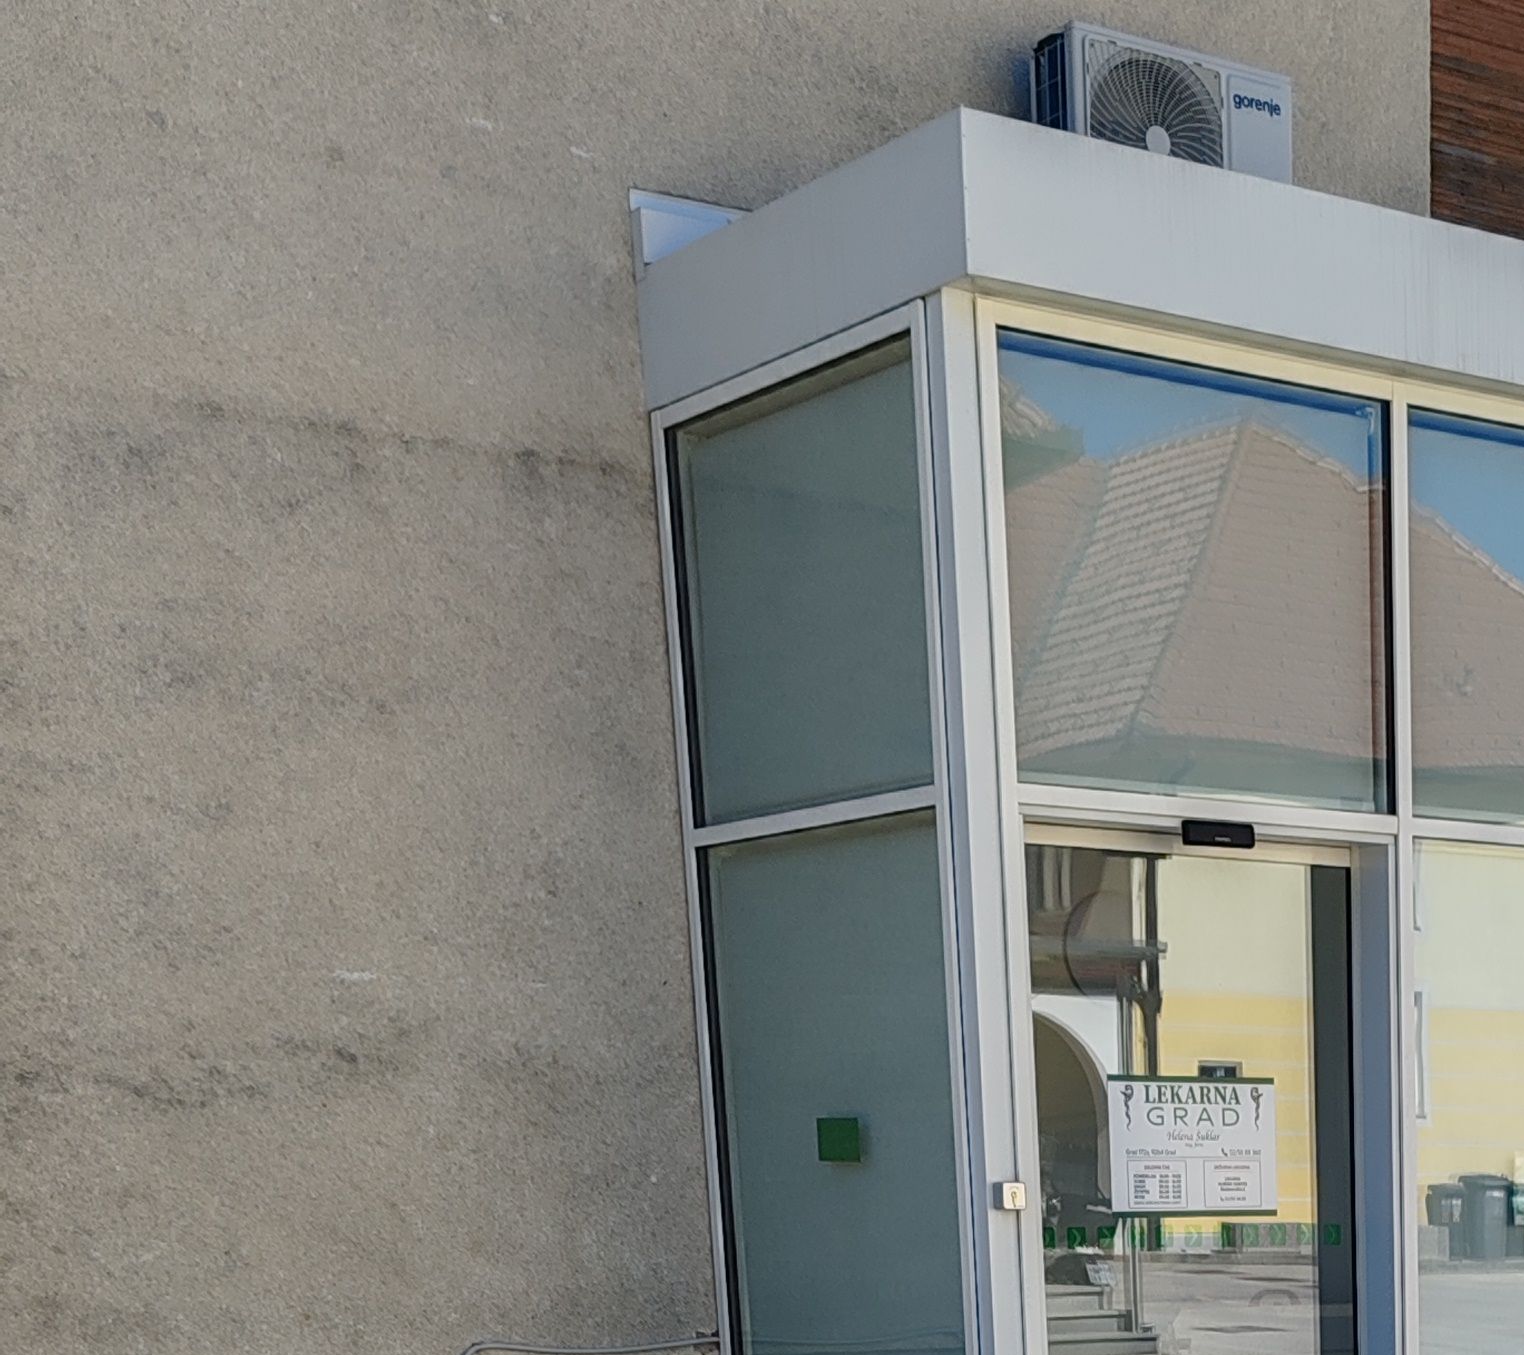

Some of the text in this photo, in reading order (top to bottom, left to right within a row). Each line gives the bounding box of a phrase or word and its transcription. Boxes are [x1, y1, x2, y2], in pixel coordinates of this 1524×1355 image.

[1232, 94, 1281, 117] gorenje
[1144, 1084, 1242, 1105] LEKARNA
[1146, 1106, 1240, 1127] GRAD
